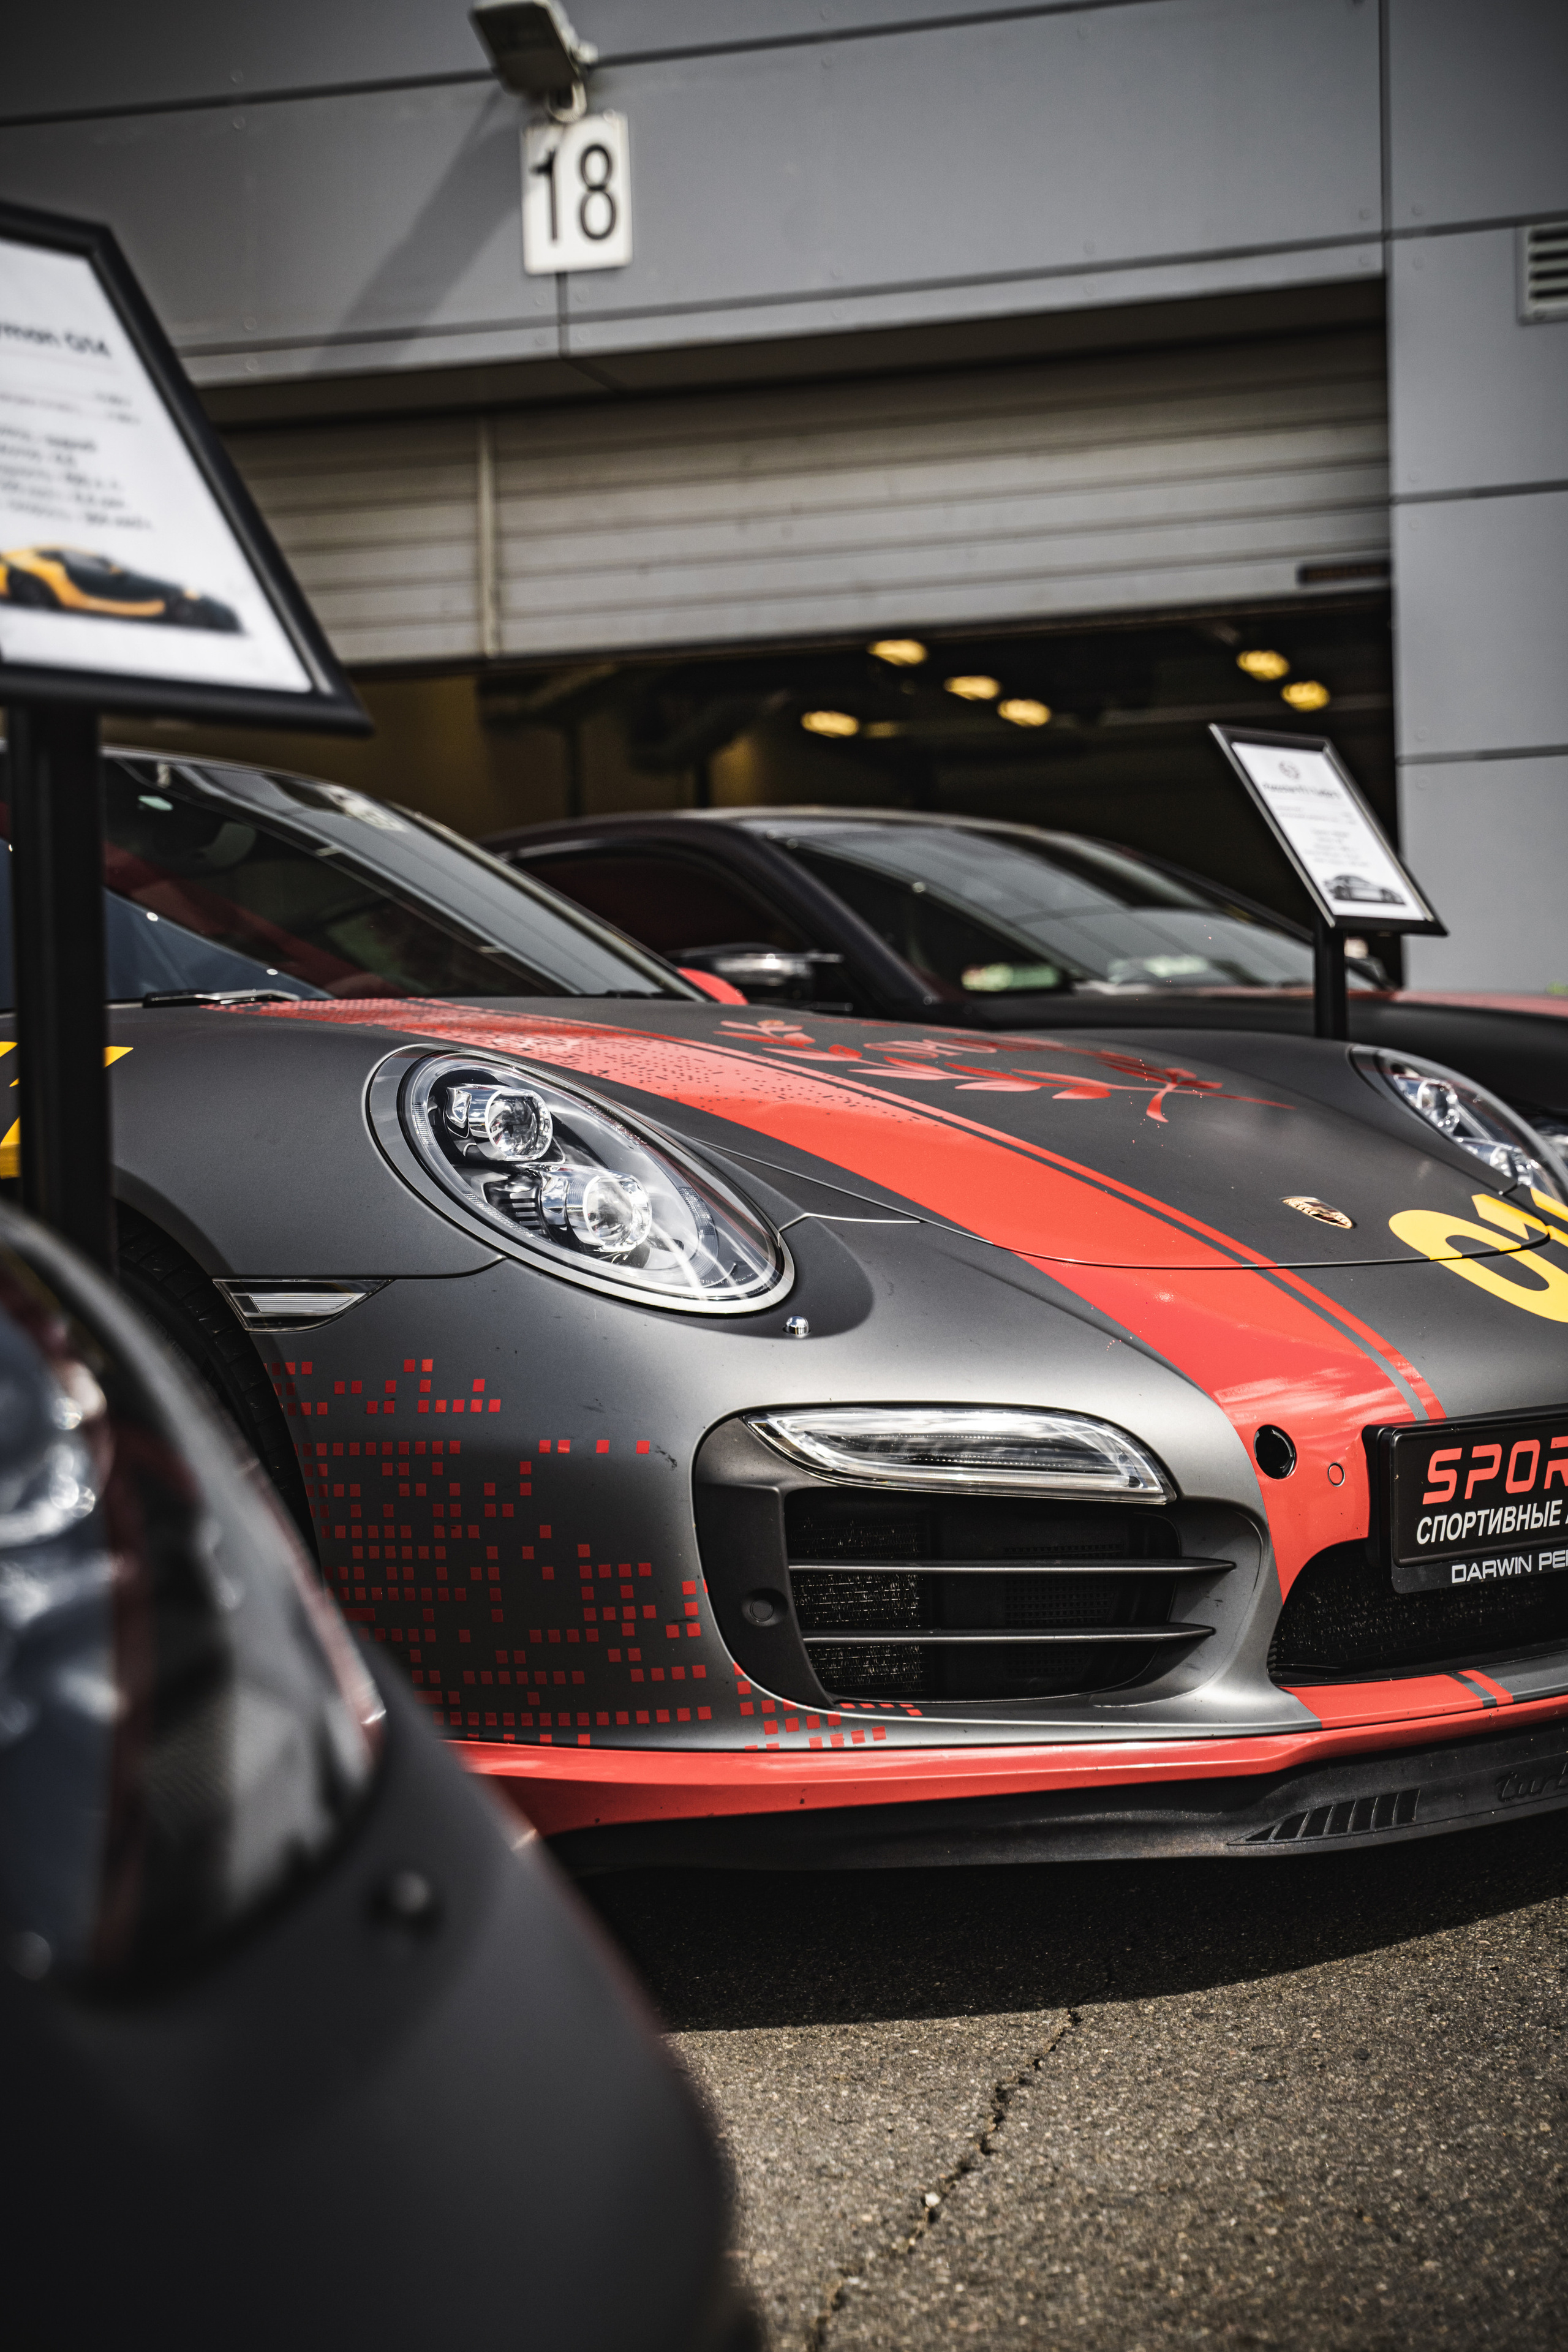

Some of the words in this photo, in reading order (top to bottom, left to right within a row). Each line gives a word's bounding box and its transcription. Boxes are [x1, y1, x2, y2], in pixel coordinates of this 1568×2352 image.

[530, 143, 618, 244] 18
[1422, 1436, 1568, 1505] SPOR
[1416, 1499, 1563, 1545] СПОРТИВНЫЕ
[1452, 1554, 1532, 1583] DARWIN
[1539, 1549, 1568, 1571] PE
